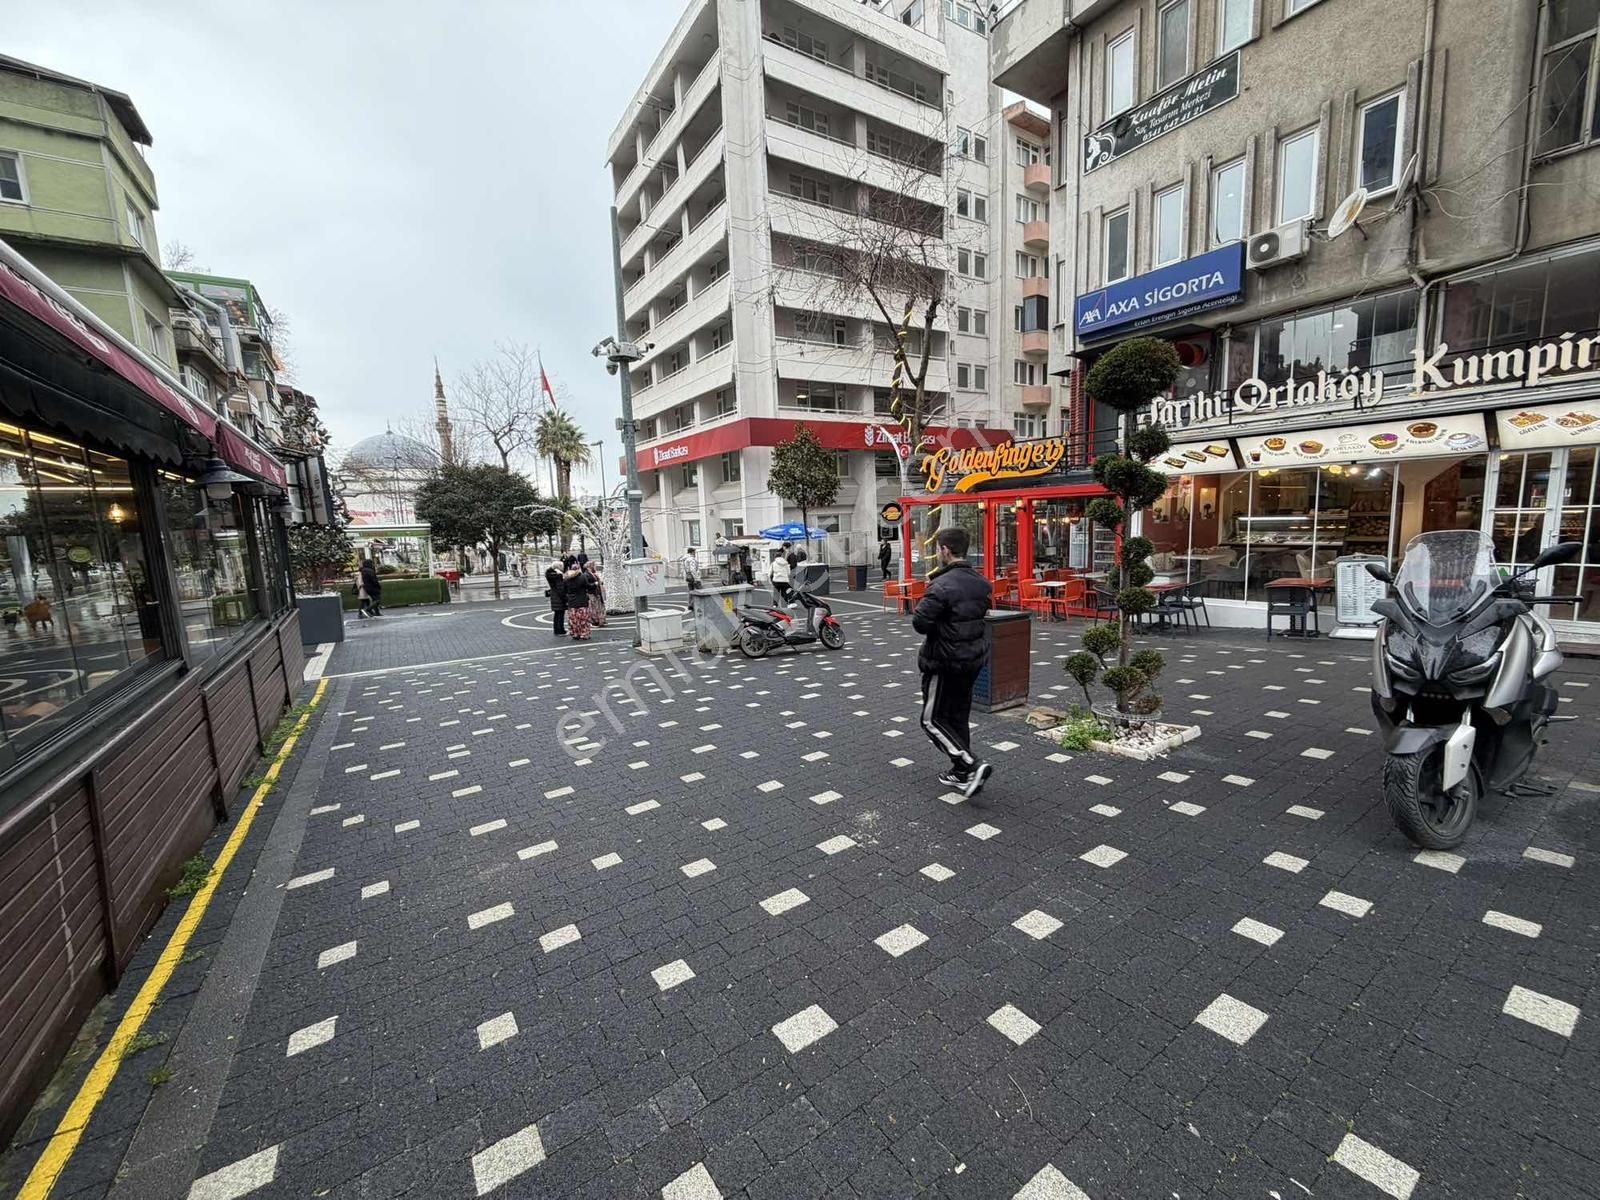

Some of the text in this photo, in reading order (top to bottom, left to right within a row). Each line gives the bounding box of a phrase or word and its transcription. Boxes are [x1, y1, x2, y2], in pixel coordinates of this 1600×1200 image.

[1130, 68, 1228, 125] Kuaför Metin
[1079, 308, 1101, 326] AXA
[1106, 297, 1140, 318] AXA
[1234, 366, 1384, 413] Ortaköy
[1409, 332, 1600, 394] Kumpir
[920, 438, 1066, 492] Goldenfingers
